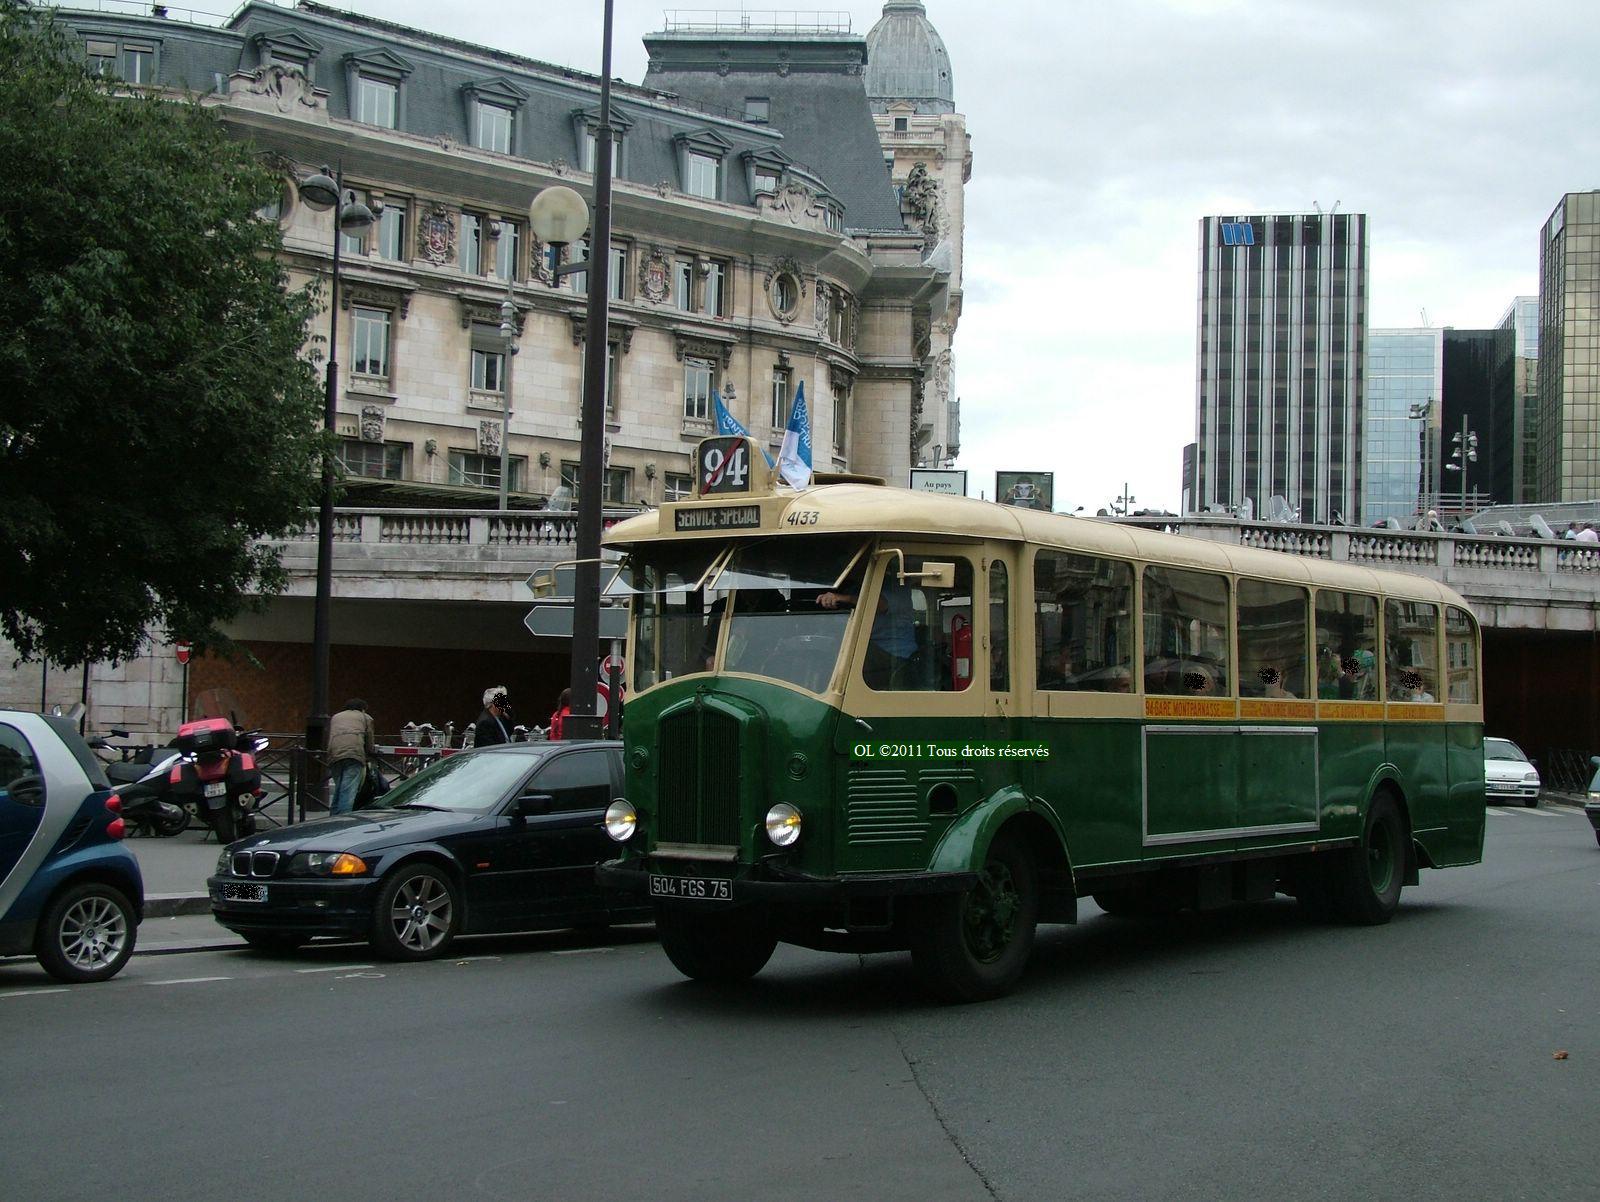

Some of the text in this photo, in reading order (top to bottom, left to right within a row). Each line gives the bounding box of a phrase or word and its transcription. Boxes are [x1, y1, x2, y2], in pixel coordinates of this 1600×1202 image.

[704, 448, 748, 487] 94
[935, 481, 952, 489] pays
[787, 511, 820, 526] 4133
[653, 877, 728, 897] 504 FGS 75
